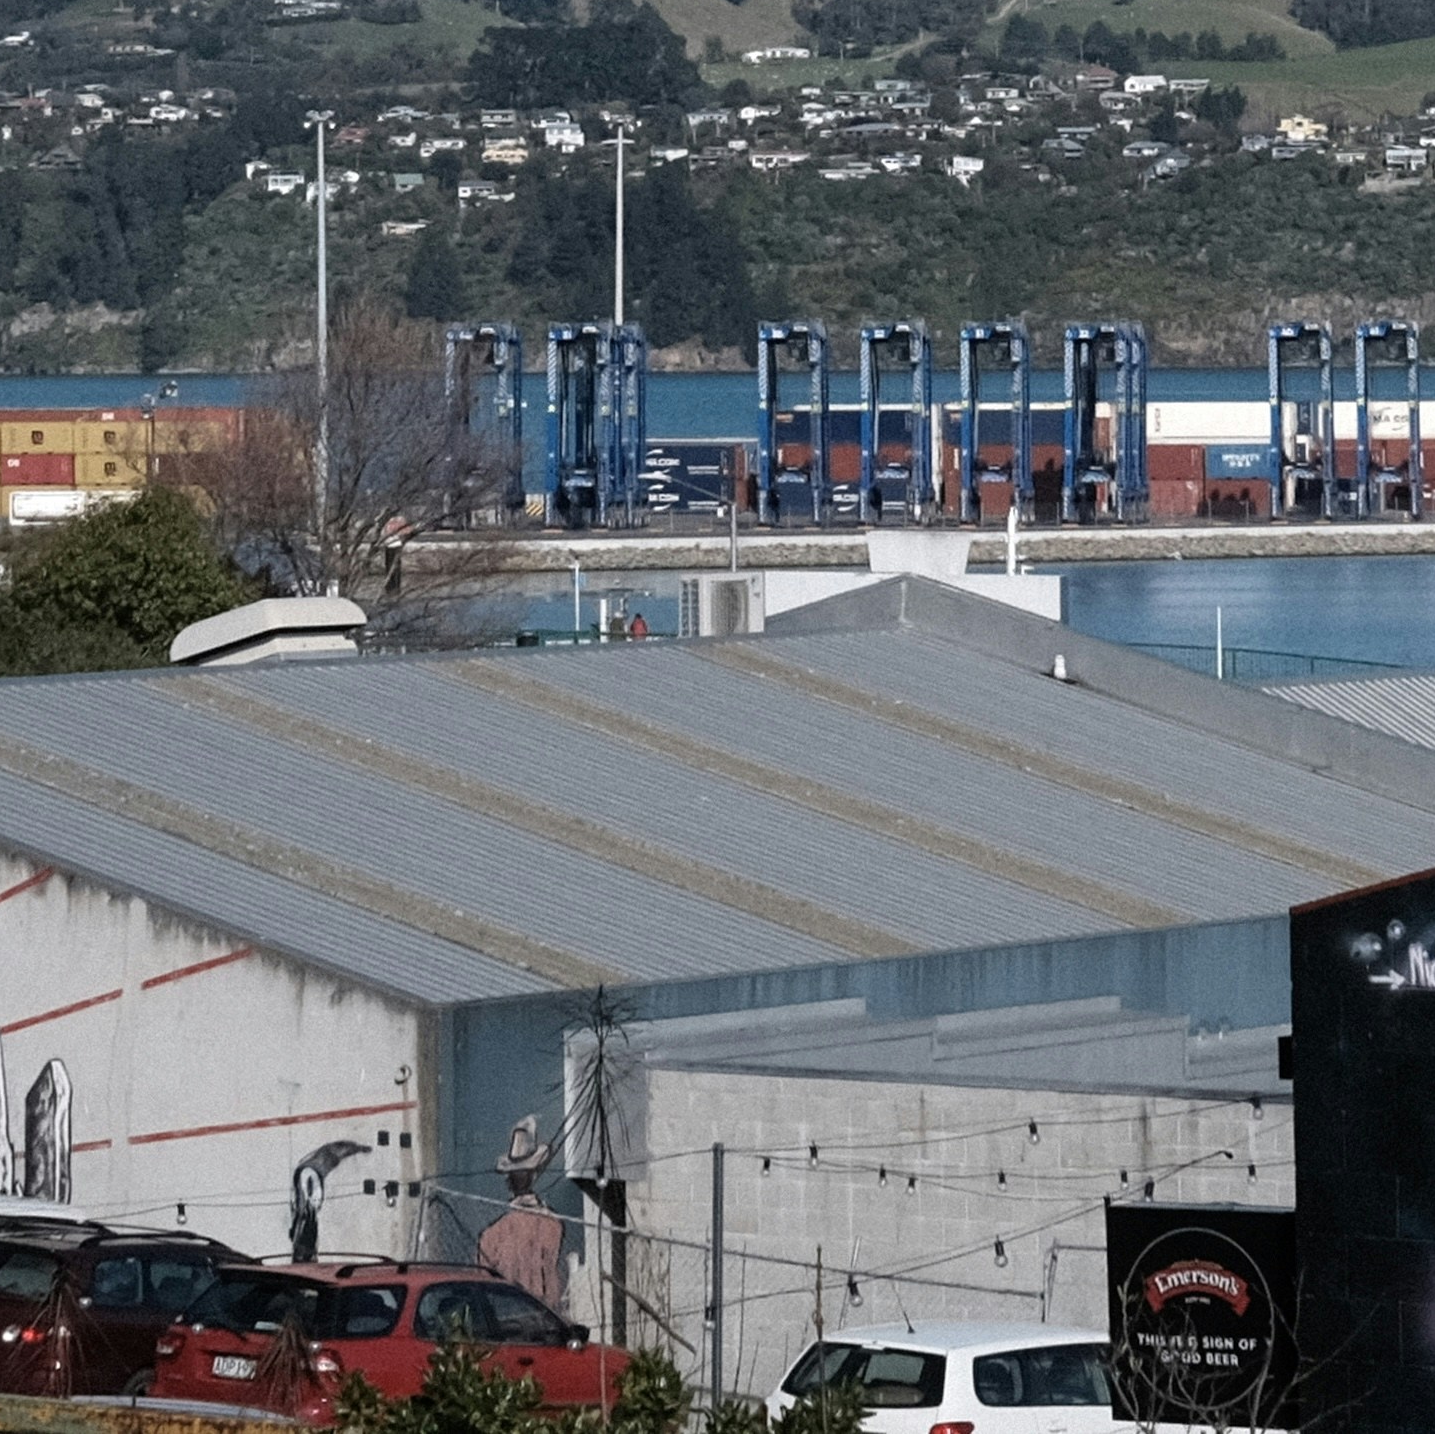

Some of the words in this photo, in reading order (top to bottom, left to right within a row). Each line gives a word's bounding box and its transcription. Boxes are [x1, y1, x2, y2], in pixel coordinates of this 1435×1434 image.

[1154, 1269, 1240, 1297] Emerson's
[1202, 1335, 1235, 1350] SIGN
[1238, 1337, 1258, 1351] OF
[1206, 1351, 1239, 1366] BEER
